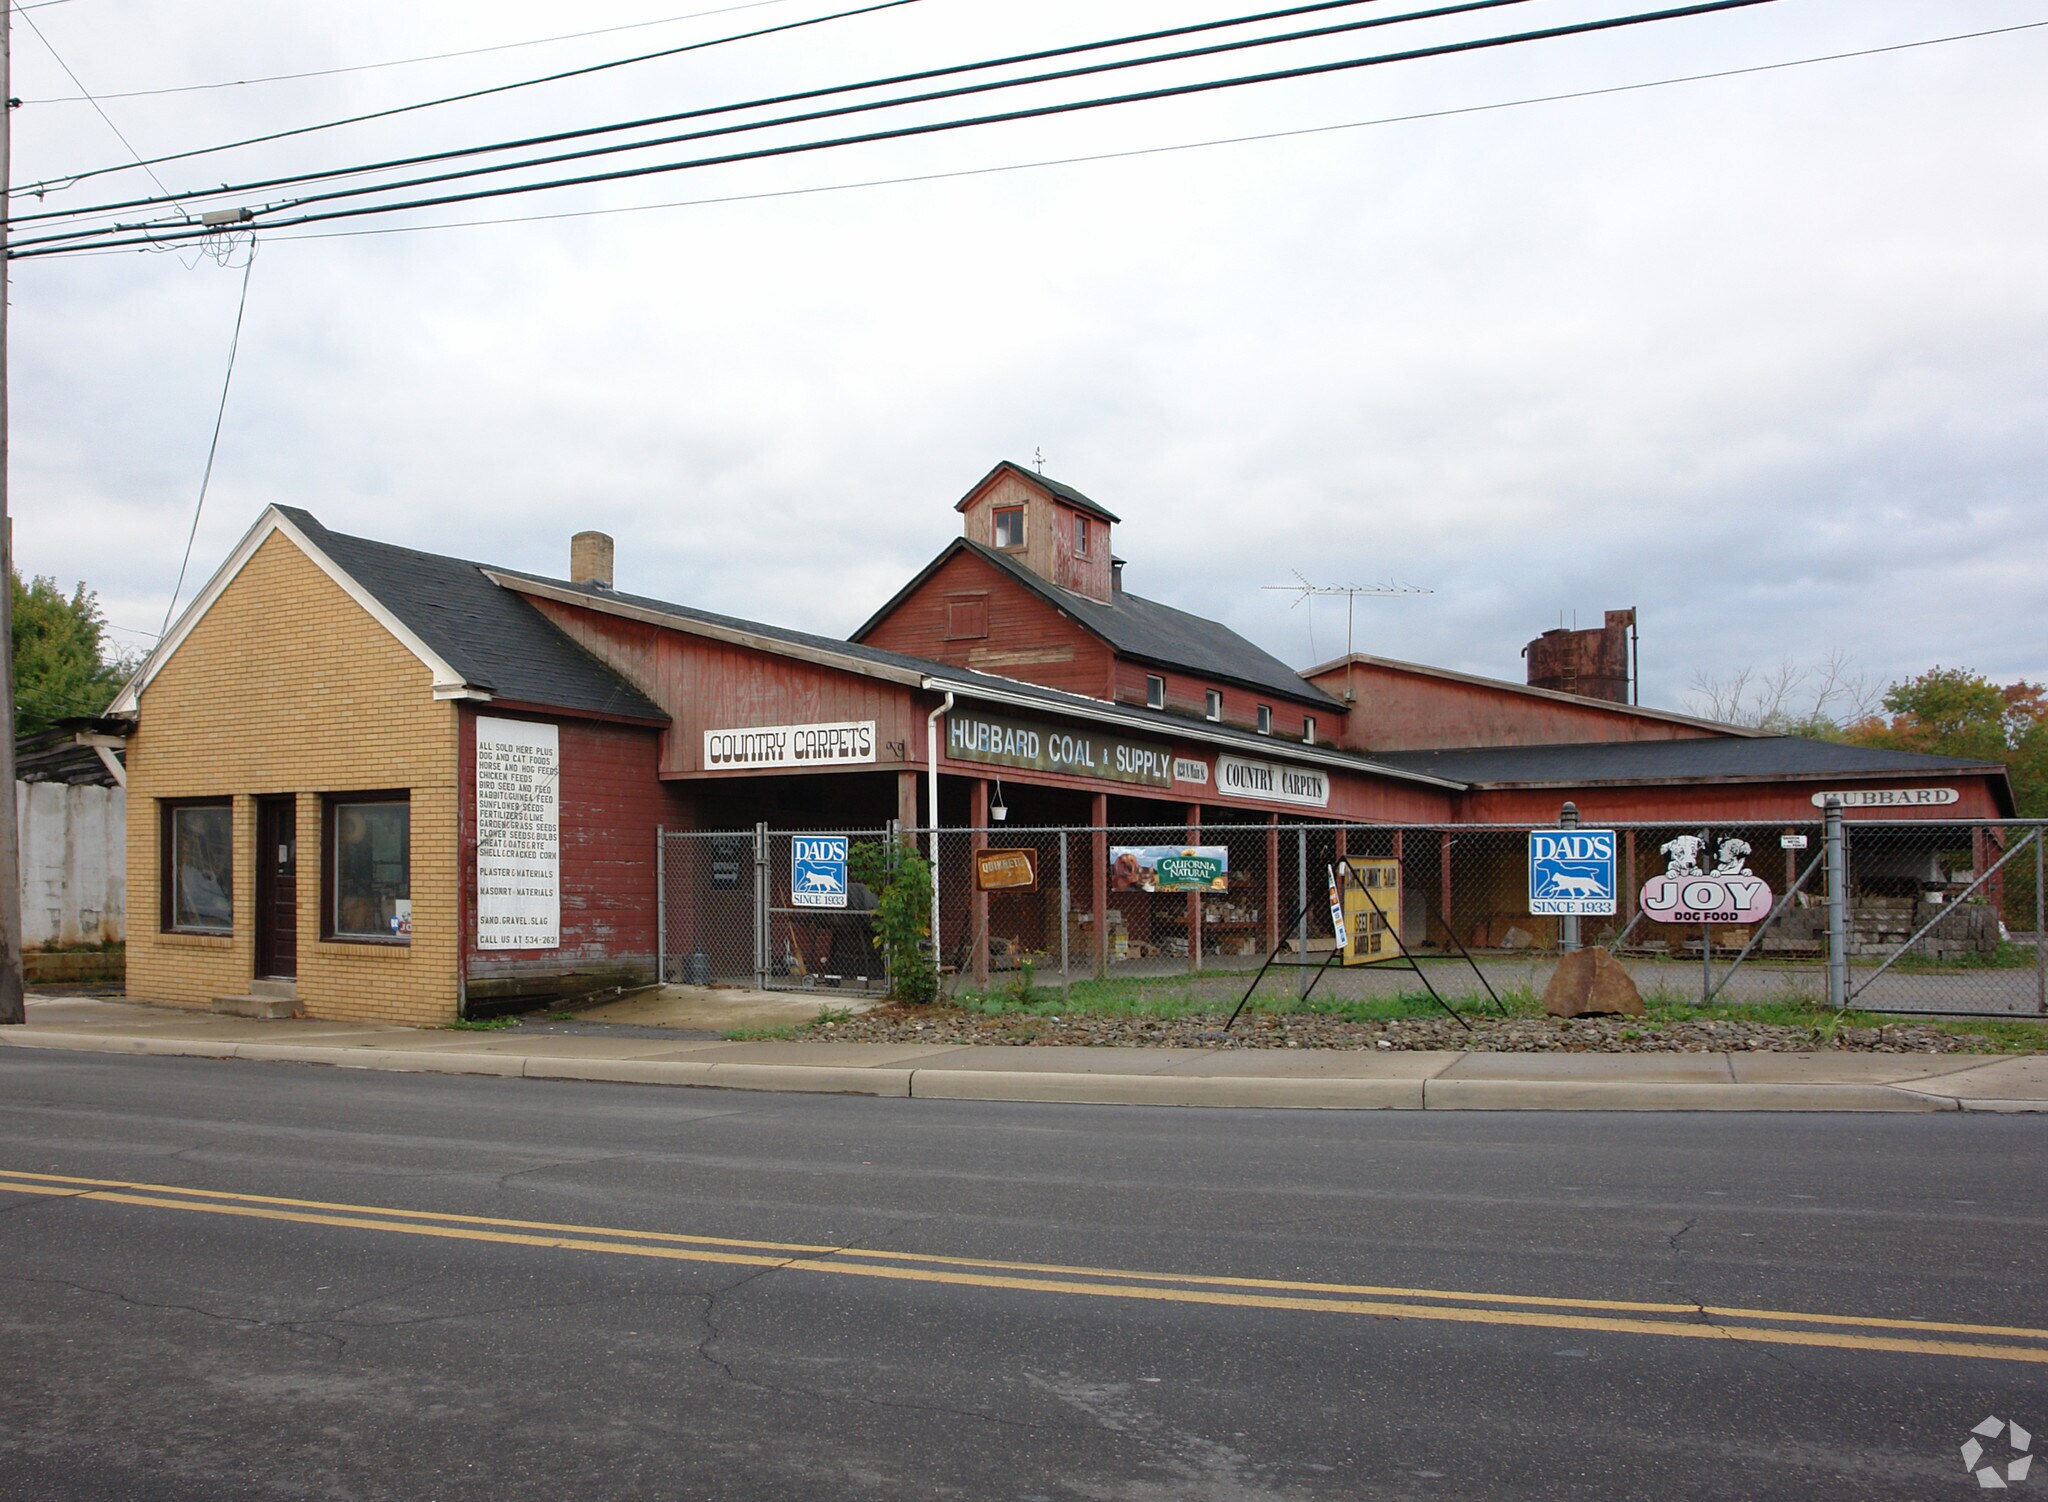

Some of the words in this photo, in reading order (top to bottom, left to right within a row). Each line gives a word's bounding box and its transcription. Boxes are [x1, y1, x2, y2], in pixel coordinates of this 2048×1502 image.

[479, 742, 492, 750] ALL
[496, 743, 513, 752] SOLD
[516, 745, 533, 754] HERE
[536, 747, 552, 756] PLUS
[710, 733, 786, 764] COUNTRY
[794, 728, 870, 759] CARPETS
[952, 718, 1039, 759] HUBBARD
[1049, 734, 1094, 767] COAL
[1103, 748, 1108, 764] &
[1116, 745, 1170, 778] SUPPLY
[479, 752, 492, 760] DOG
[496, 753, 509, 762] AND
[513, 755, 525, 763] CAT
[530, 756, 550, 765] FOODS
[479, 762, 501, 770] HORSE
[505, 764, 518, 772] AND
[522, 765, 534, 774] HOG
[538, 767, 558, 776] FEEDS
[479, 771, 507, 780] CHICKEN
[511, 774, 532, 782] FEEDS
[1226, 764, 1274, 791] COUNTRY
[1282, 772, 1322, 798] CARPETS
[479, 781, 494, 790] BIRD
[498, 782, 515, 791] SEED
[519, 784, 531, 792] AND
[535, 785, 551, 794] FEED
[537, 795, 553, 804] FEED
[480, 801, 520, 811] SUNFLOWER
[523, 803, 544, 812] SEEDS
[480, 829, 506, 838] FLOWER
[536, 823, 556, 832] SEEDS
[795, 841, 845, 861] DAD'S
[1534, 836, 1611, 860] DAD'S
[1163, 860, 1216, 872] CALIFORNIA
[1170, 868, 1210, 879] NATURAL
[794, 894, 821, 905] SINCE
[824, 895, 844, 905] 1933
[1646, 881, 1762, 910] JOY
[1533, 901, 1575, 913] SINCE
[1581, 901, 1611, 913] 1933
[1675, 912, 1700, 921] DOG
[1704, 912, 1738, 921] FOOD
